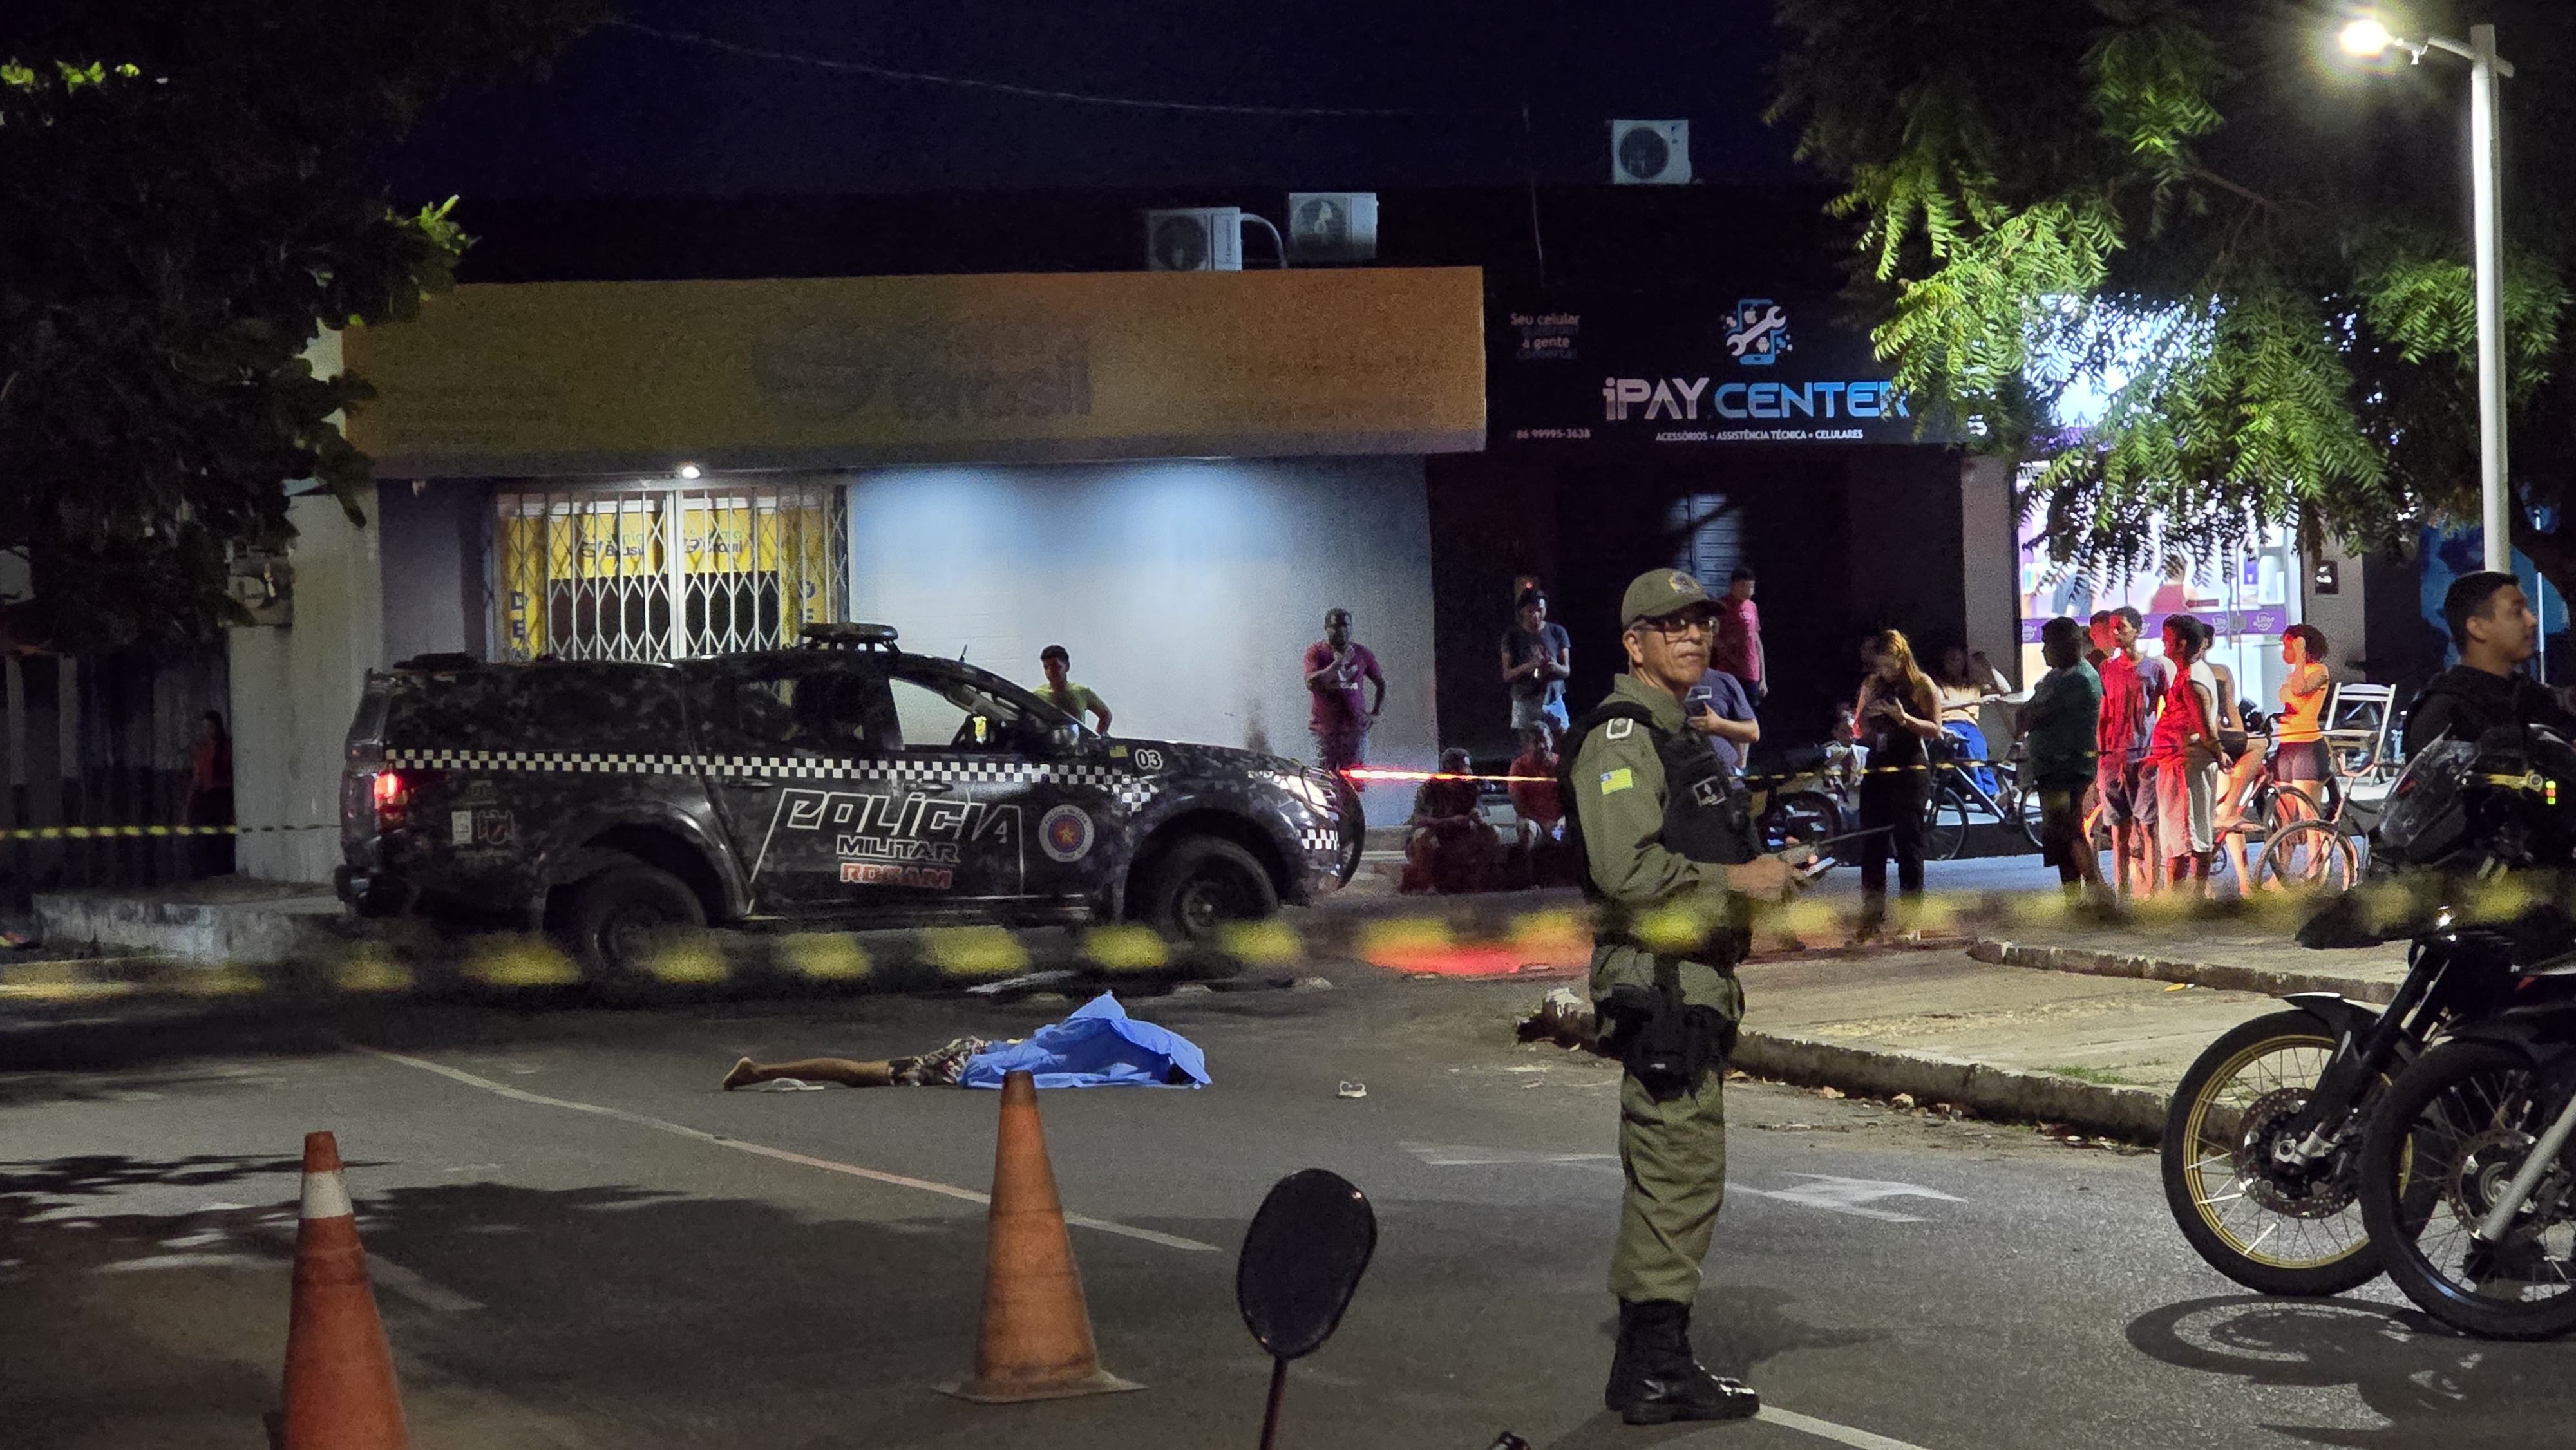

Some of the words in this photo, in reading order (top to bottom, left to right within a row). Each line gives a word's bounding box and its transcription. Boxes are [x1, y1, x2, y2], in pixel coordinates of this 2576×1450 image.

[1510, 312, 1534, 326] Seu
[1537, 312, 1582, 325] celular
[1533, 337, 1571, 350] gente
[1602, 377, 1709, 421] iPAY
[1714, 381, 1910, 419] CENTER
[1716, 429, 1770, 440] ASSISTÊNCIA
[1770, 429, 1807, 440] TÉCNICA
[1815, 429, 1864, 439] CELULARES
[1135, 749, 1163, 770] 03
[776, 787, 1023, 845] POLÍCIA
[836, 834, 961, 863] MILITAR
